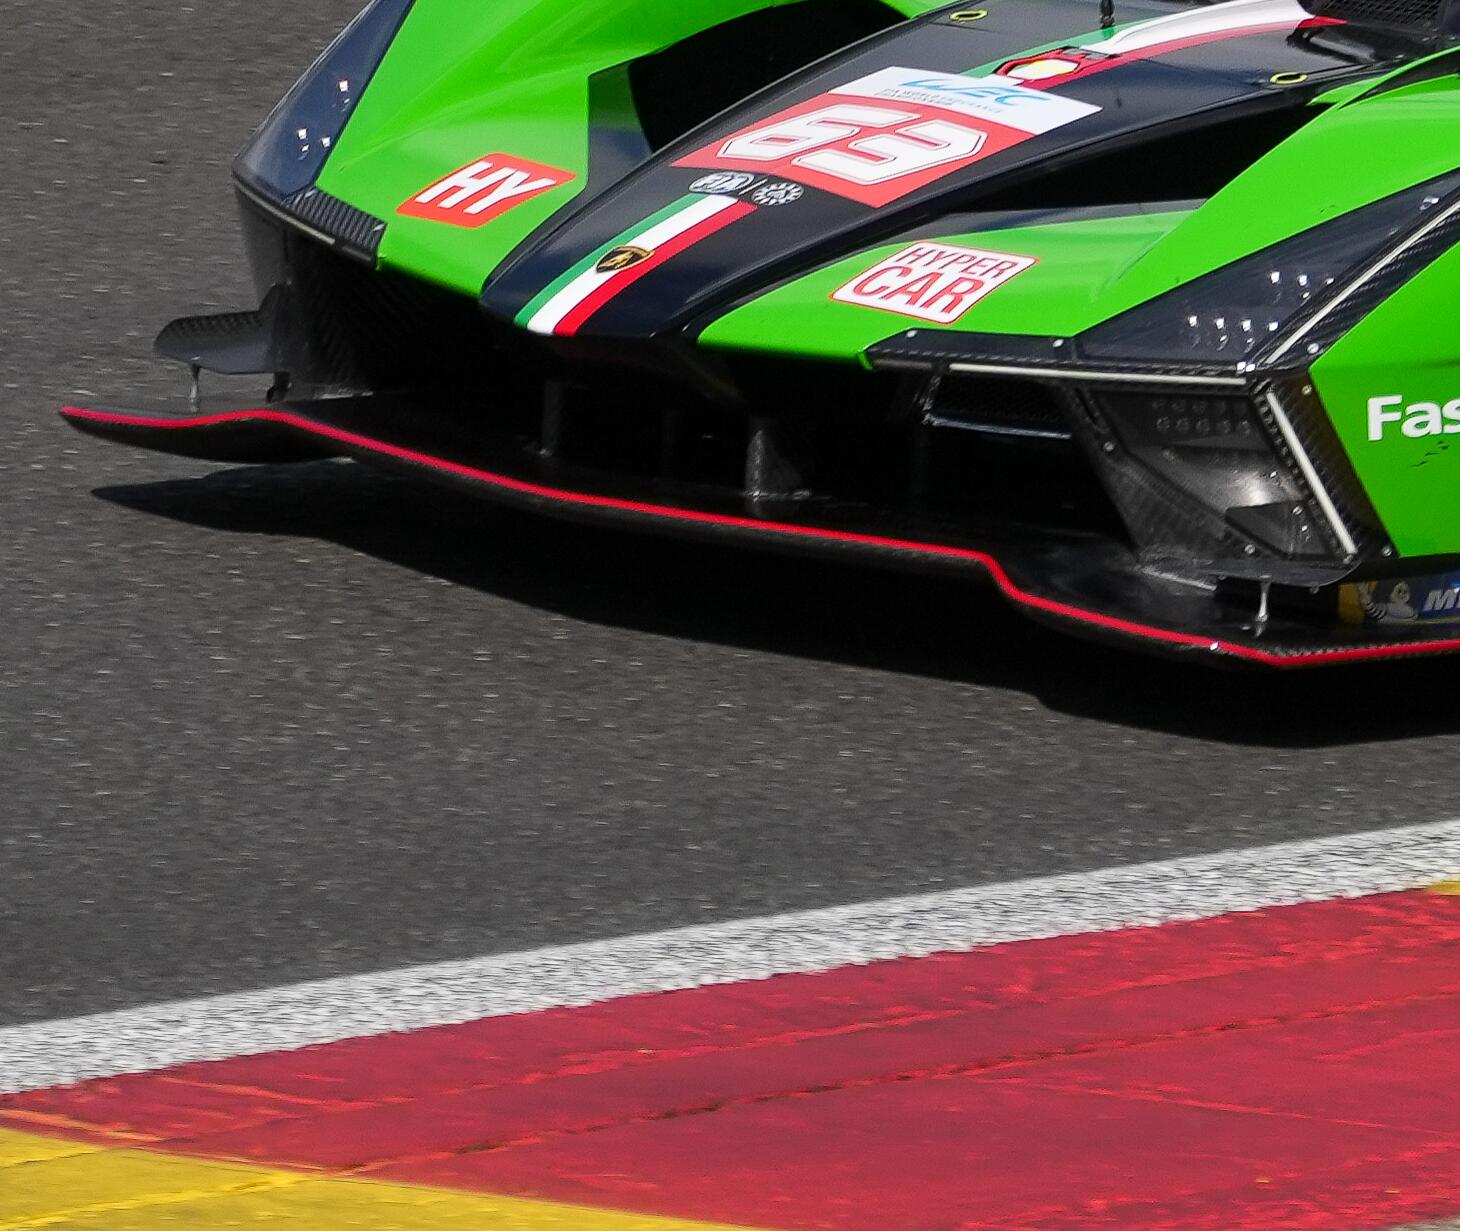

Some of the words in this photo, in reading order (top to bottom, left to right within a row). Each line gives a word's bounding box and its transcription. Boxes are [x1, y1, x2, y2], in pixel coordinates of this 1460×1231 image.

[717, 103, 988, 186] 63
[414, 160, 557, 215] HY
[894, 247, 1019, 279] HYPER
[852, 265, 985, 314] CAR
